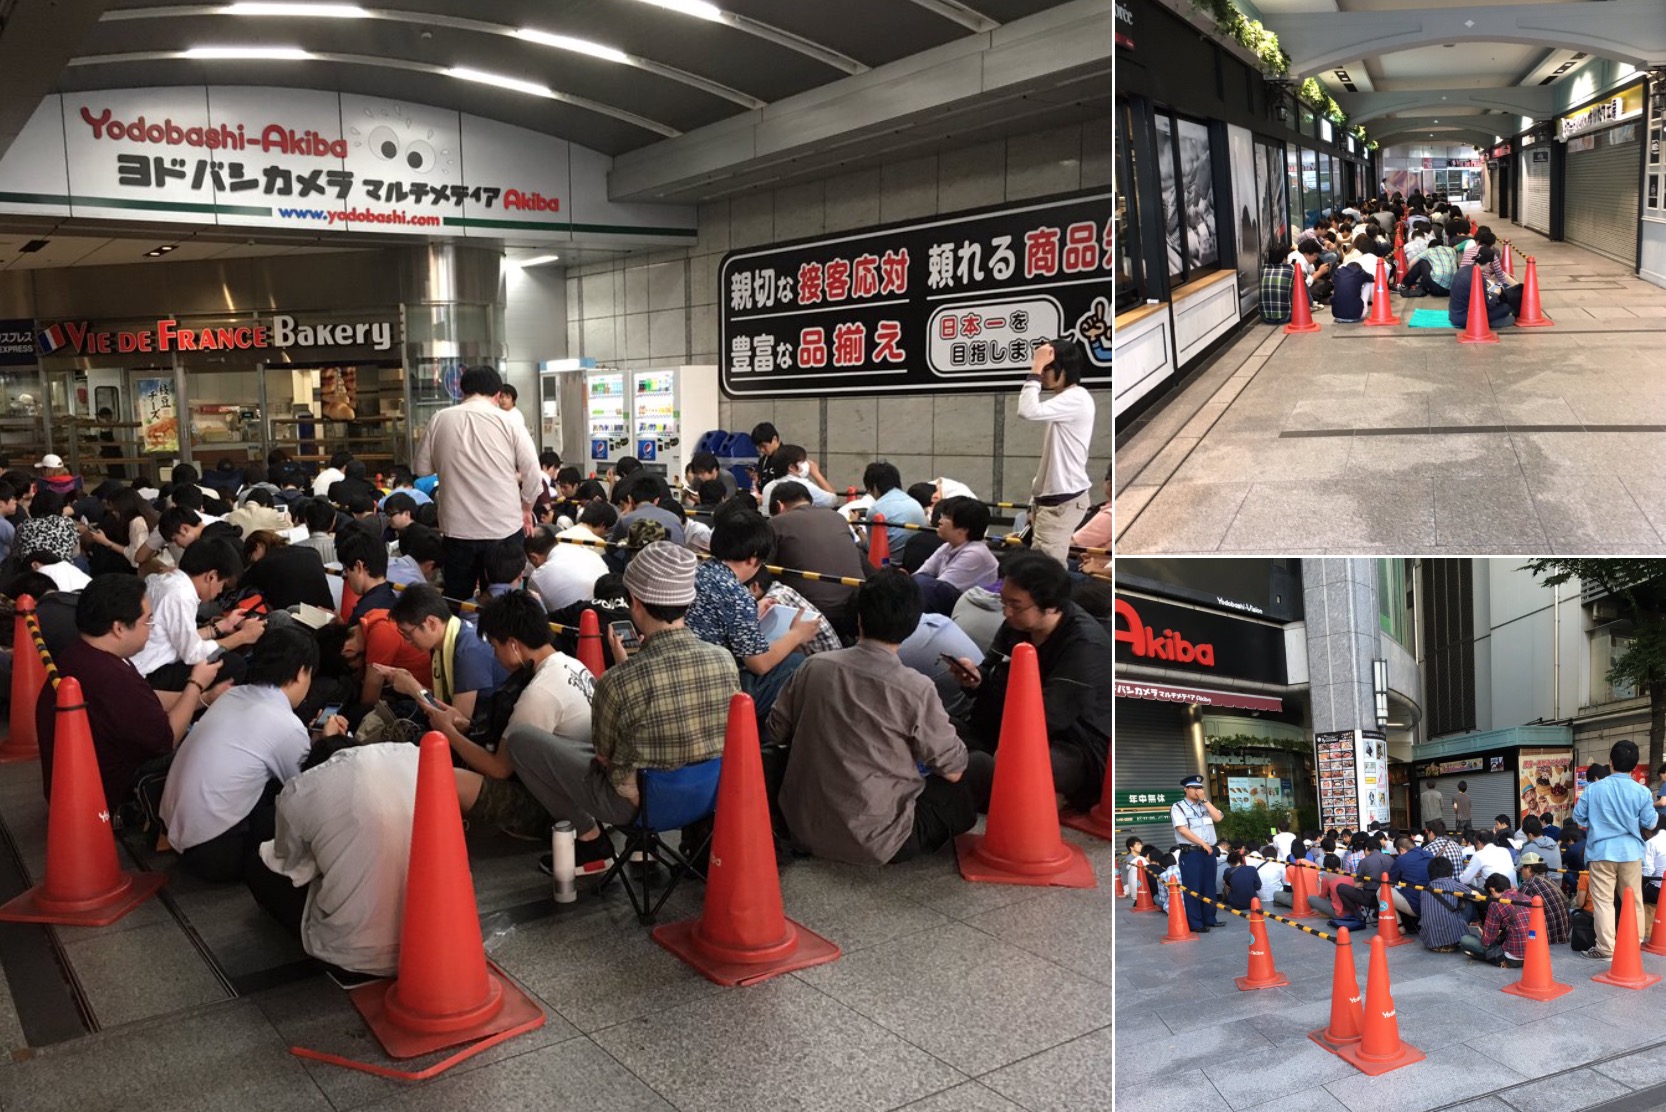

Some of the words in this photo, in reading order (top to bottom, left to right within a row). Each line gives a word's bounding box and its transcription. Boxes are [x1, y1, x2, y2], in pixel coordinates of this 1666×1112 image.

[80, 106, 348, 158] Yodobashi-Akiba
[117, 153, 354, 199] ヨドバシカメラ
[362, 178, 501, 208] マルチメディア
[502, 187, 560, 213] Akiba
[730, 246, 910, 312] 親切な接客応対
[64, 320, 111, 354] VIE
[118, 330, 152, 353] DE
[157, 318, 268, 351] FRANCE
[273, 314, 392, 350] Bakery
[730, 320, 907, 374] 豊富な品揃え
[939, 309, 1029, 341] 日本一を
[148, 390, 161, 420] チーズ
[1115, 597, 1215, 667] Akiba
[1129, 793, 1166, 804] 年中無休
